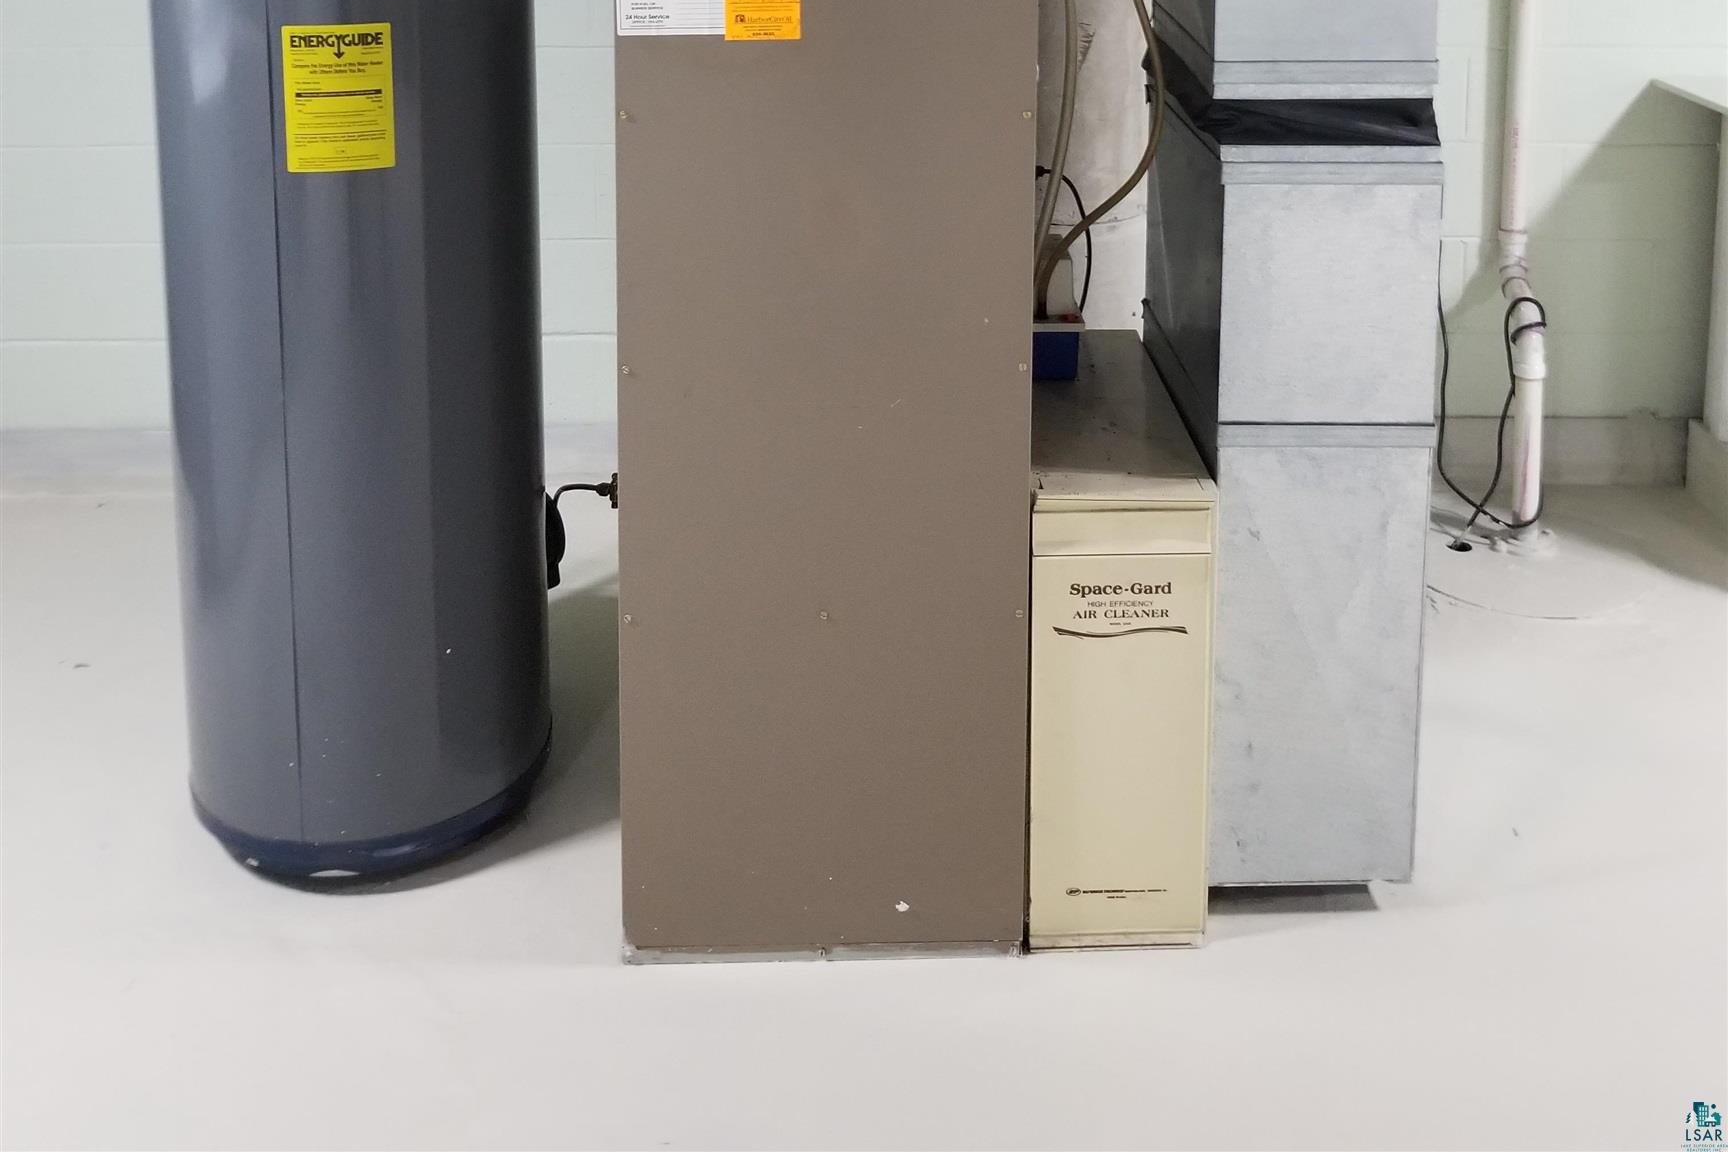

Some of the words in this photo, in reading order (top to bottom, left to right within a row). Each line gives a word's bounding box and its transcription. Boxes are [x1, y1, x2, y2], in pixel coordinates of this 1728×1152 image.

[290, 32, 383, 48] ENERGYGUIDE
[1069, 582, 1172, 598] Space-Gard
[1073, 610, 1097, 619] AIR
[1104, 609, 1170, 619] CLEANER
